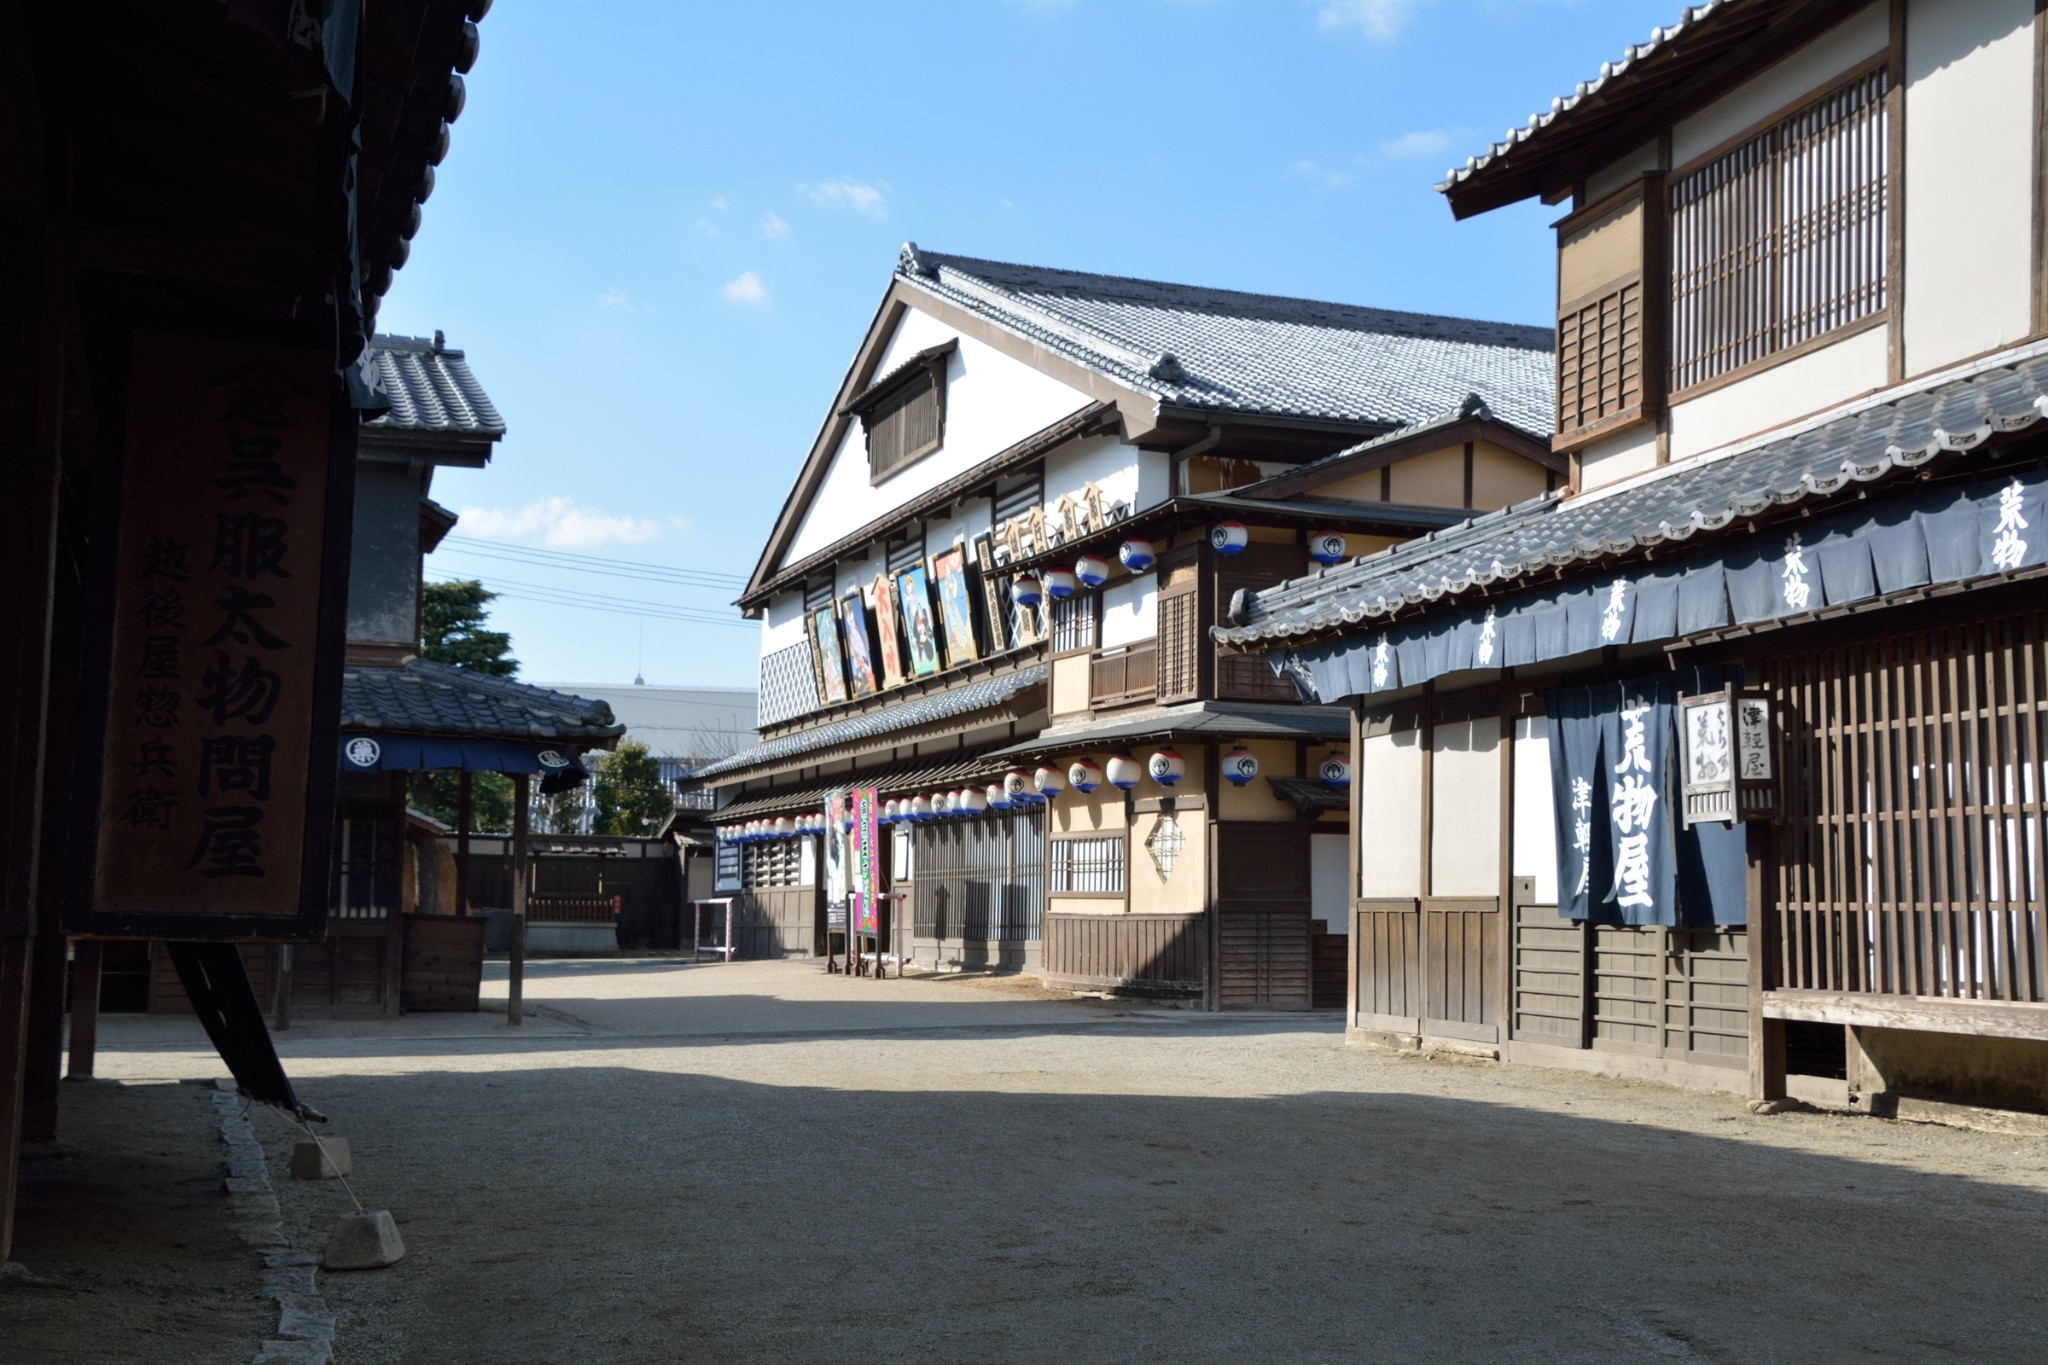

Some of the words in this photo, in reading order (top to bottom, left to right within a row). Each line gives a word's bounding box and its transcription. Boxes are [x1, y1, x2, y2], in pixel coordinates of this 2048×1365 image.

[1991, 476, 2029, 569] 荒物
[184, 431, 297, 879] 呉服太物問屋
[1602, 693, 1658, 908] 荒物屋
